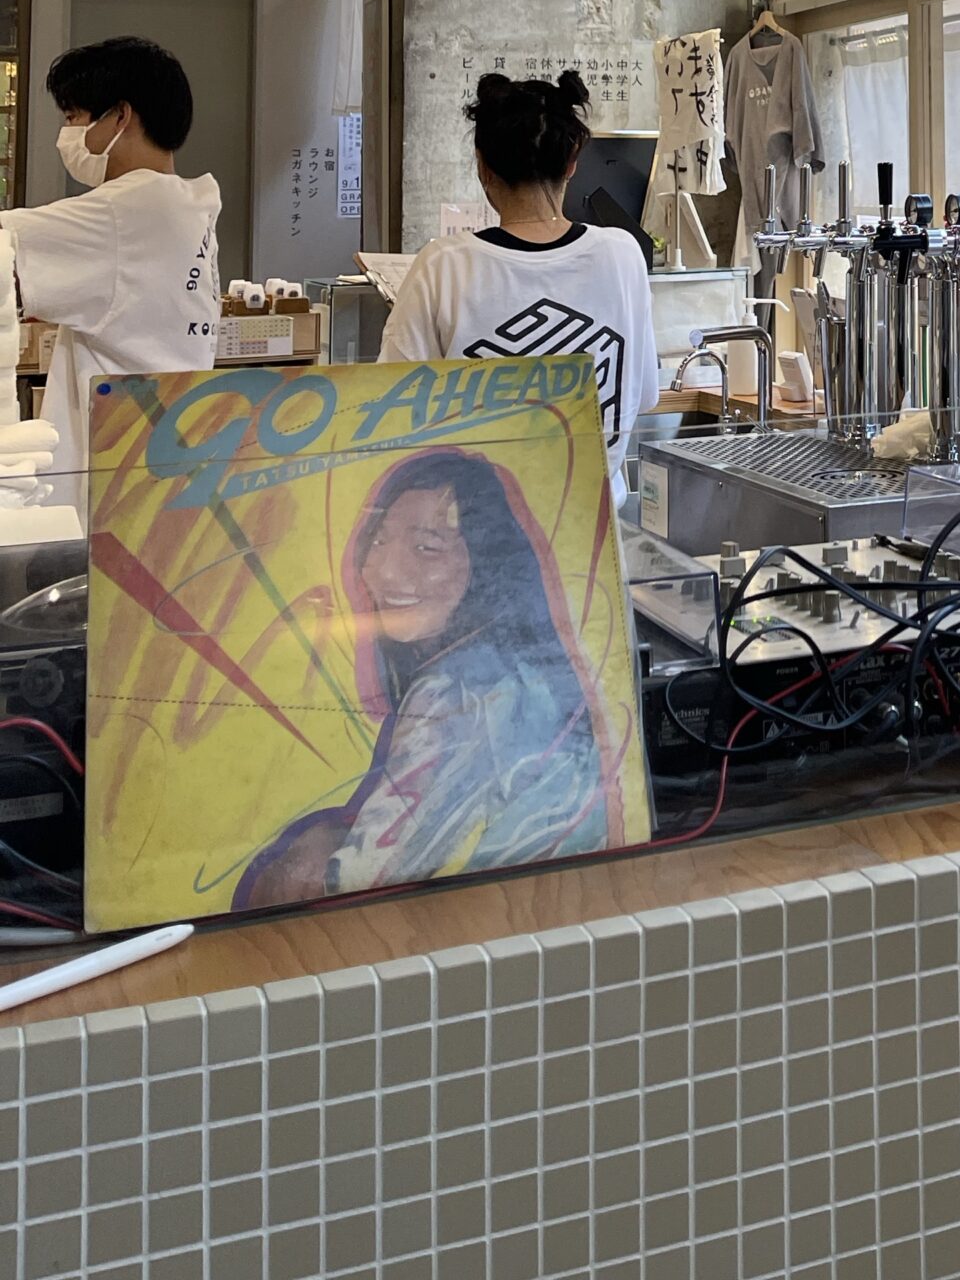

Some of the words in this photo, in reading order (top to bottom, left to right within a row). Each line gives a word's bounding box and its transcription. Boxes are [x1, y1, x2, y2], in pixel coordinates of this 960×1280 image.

[462, 57, 473, 99] ビール
[587, 58, 598, 86] 幼児
[601, 59, 613, 102] 小学生
[617, 59, 628, 102] 中学生
[632, 60, 643, 86] 大人
[308, 148, 319, 199] ラウンジ
[324, 148, 335, 172] お宿
[291, 148, 303, 237] コガネキッチン
[340, 193, 361, 201] GRA
[340, 205, 361, 214] OPE
[186, 267, 201, 291] 90
[145, 368, 338, 510] GO
[351, 360, 592, 442] AHEAD!
[241, 461, 310, 490] TATSU
[661, 706, 710, 720] Tchnics
